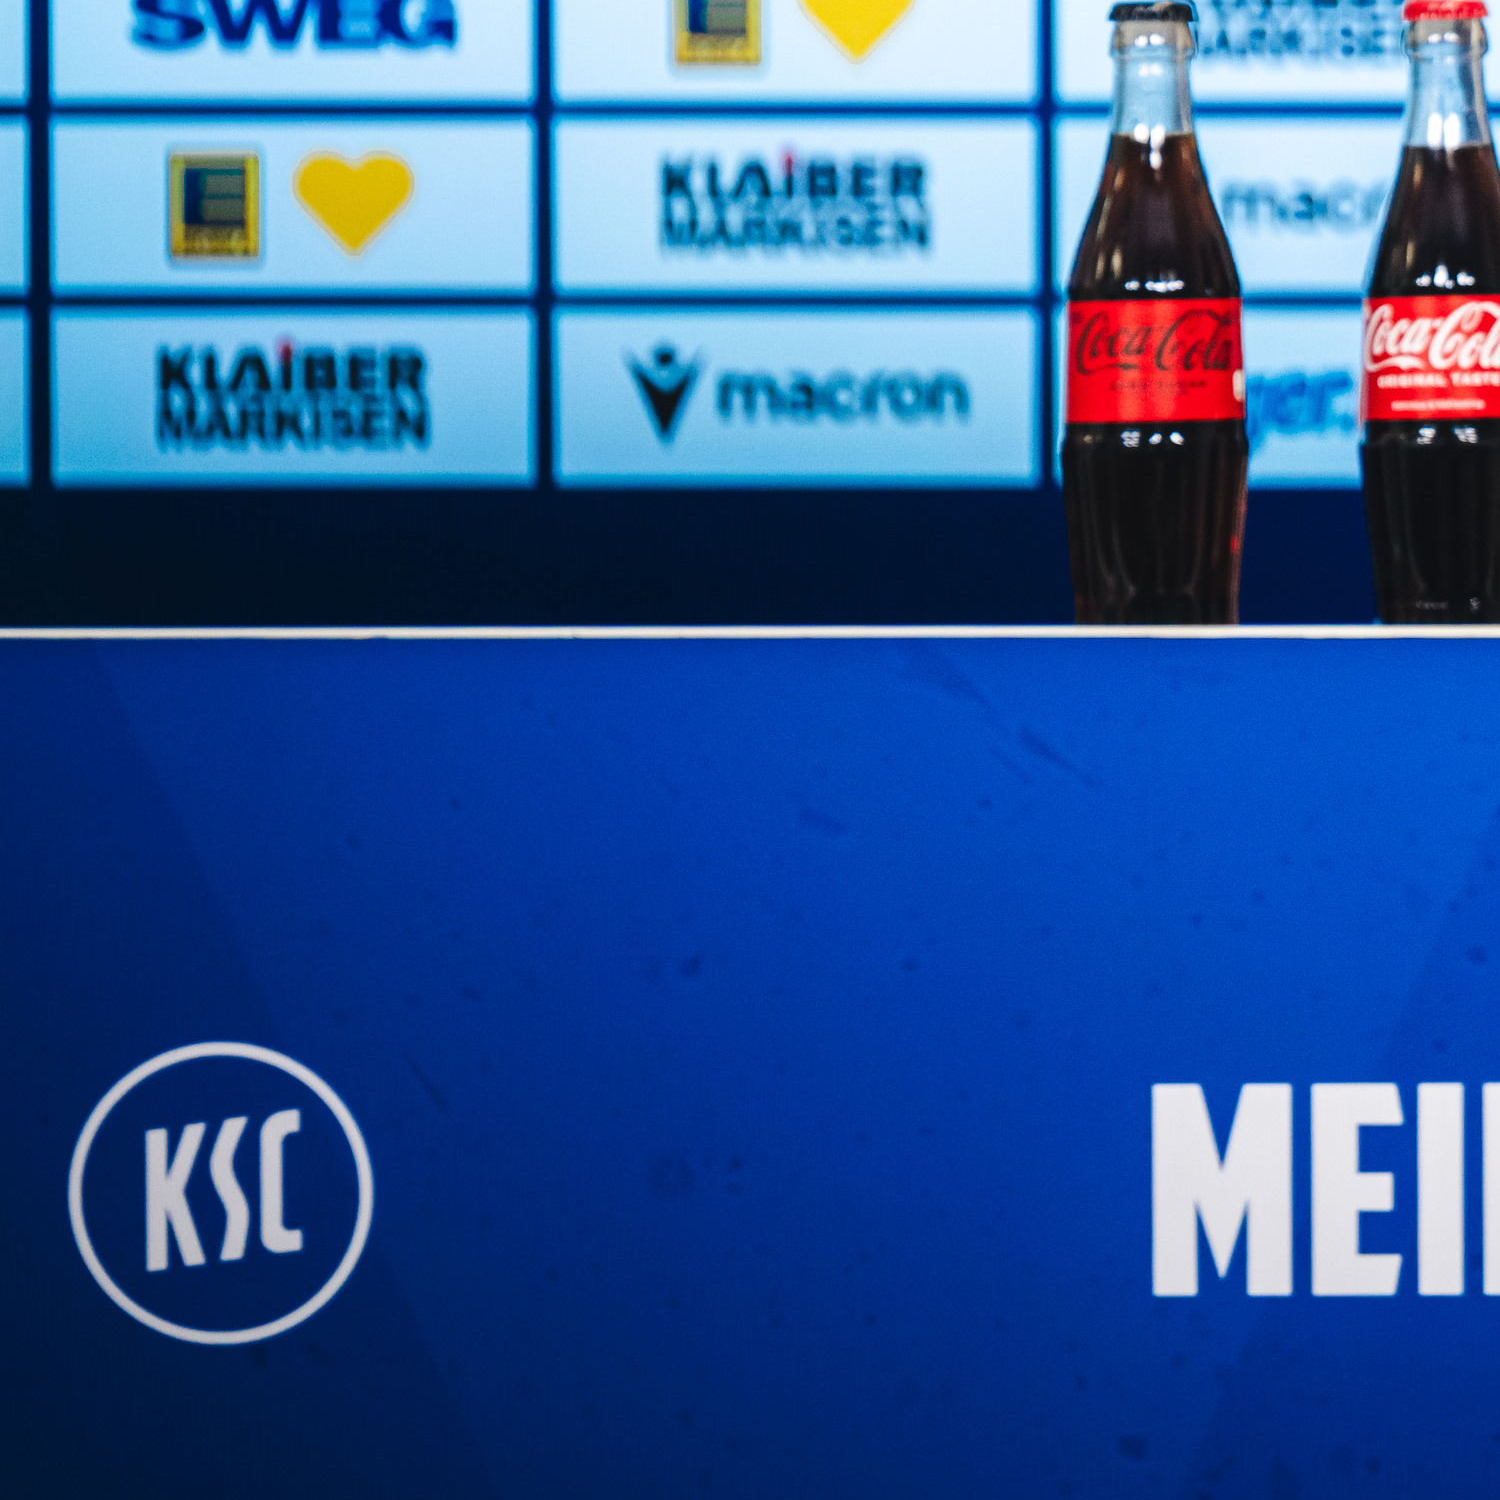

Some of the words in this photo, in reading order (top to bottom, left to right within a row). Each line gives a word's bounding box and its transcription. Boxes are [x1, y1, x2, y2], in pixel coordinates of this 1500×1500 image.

[1077, 309, 1232, 375] Coca-Cola
[716, 369, 970, 421] macron
[145, 1108, 303, 1273] KSC
